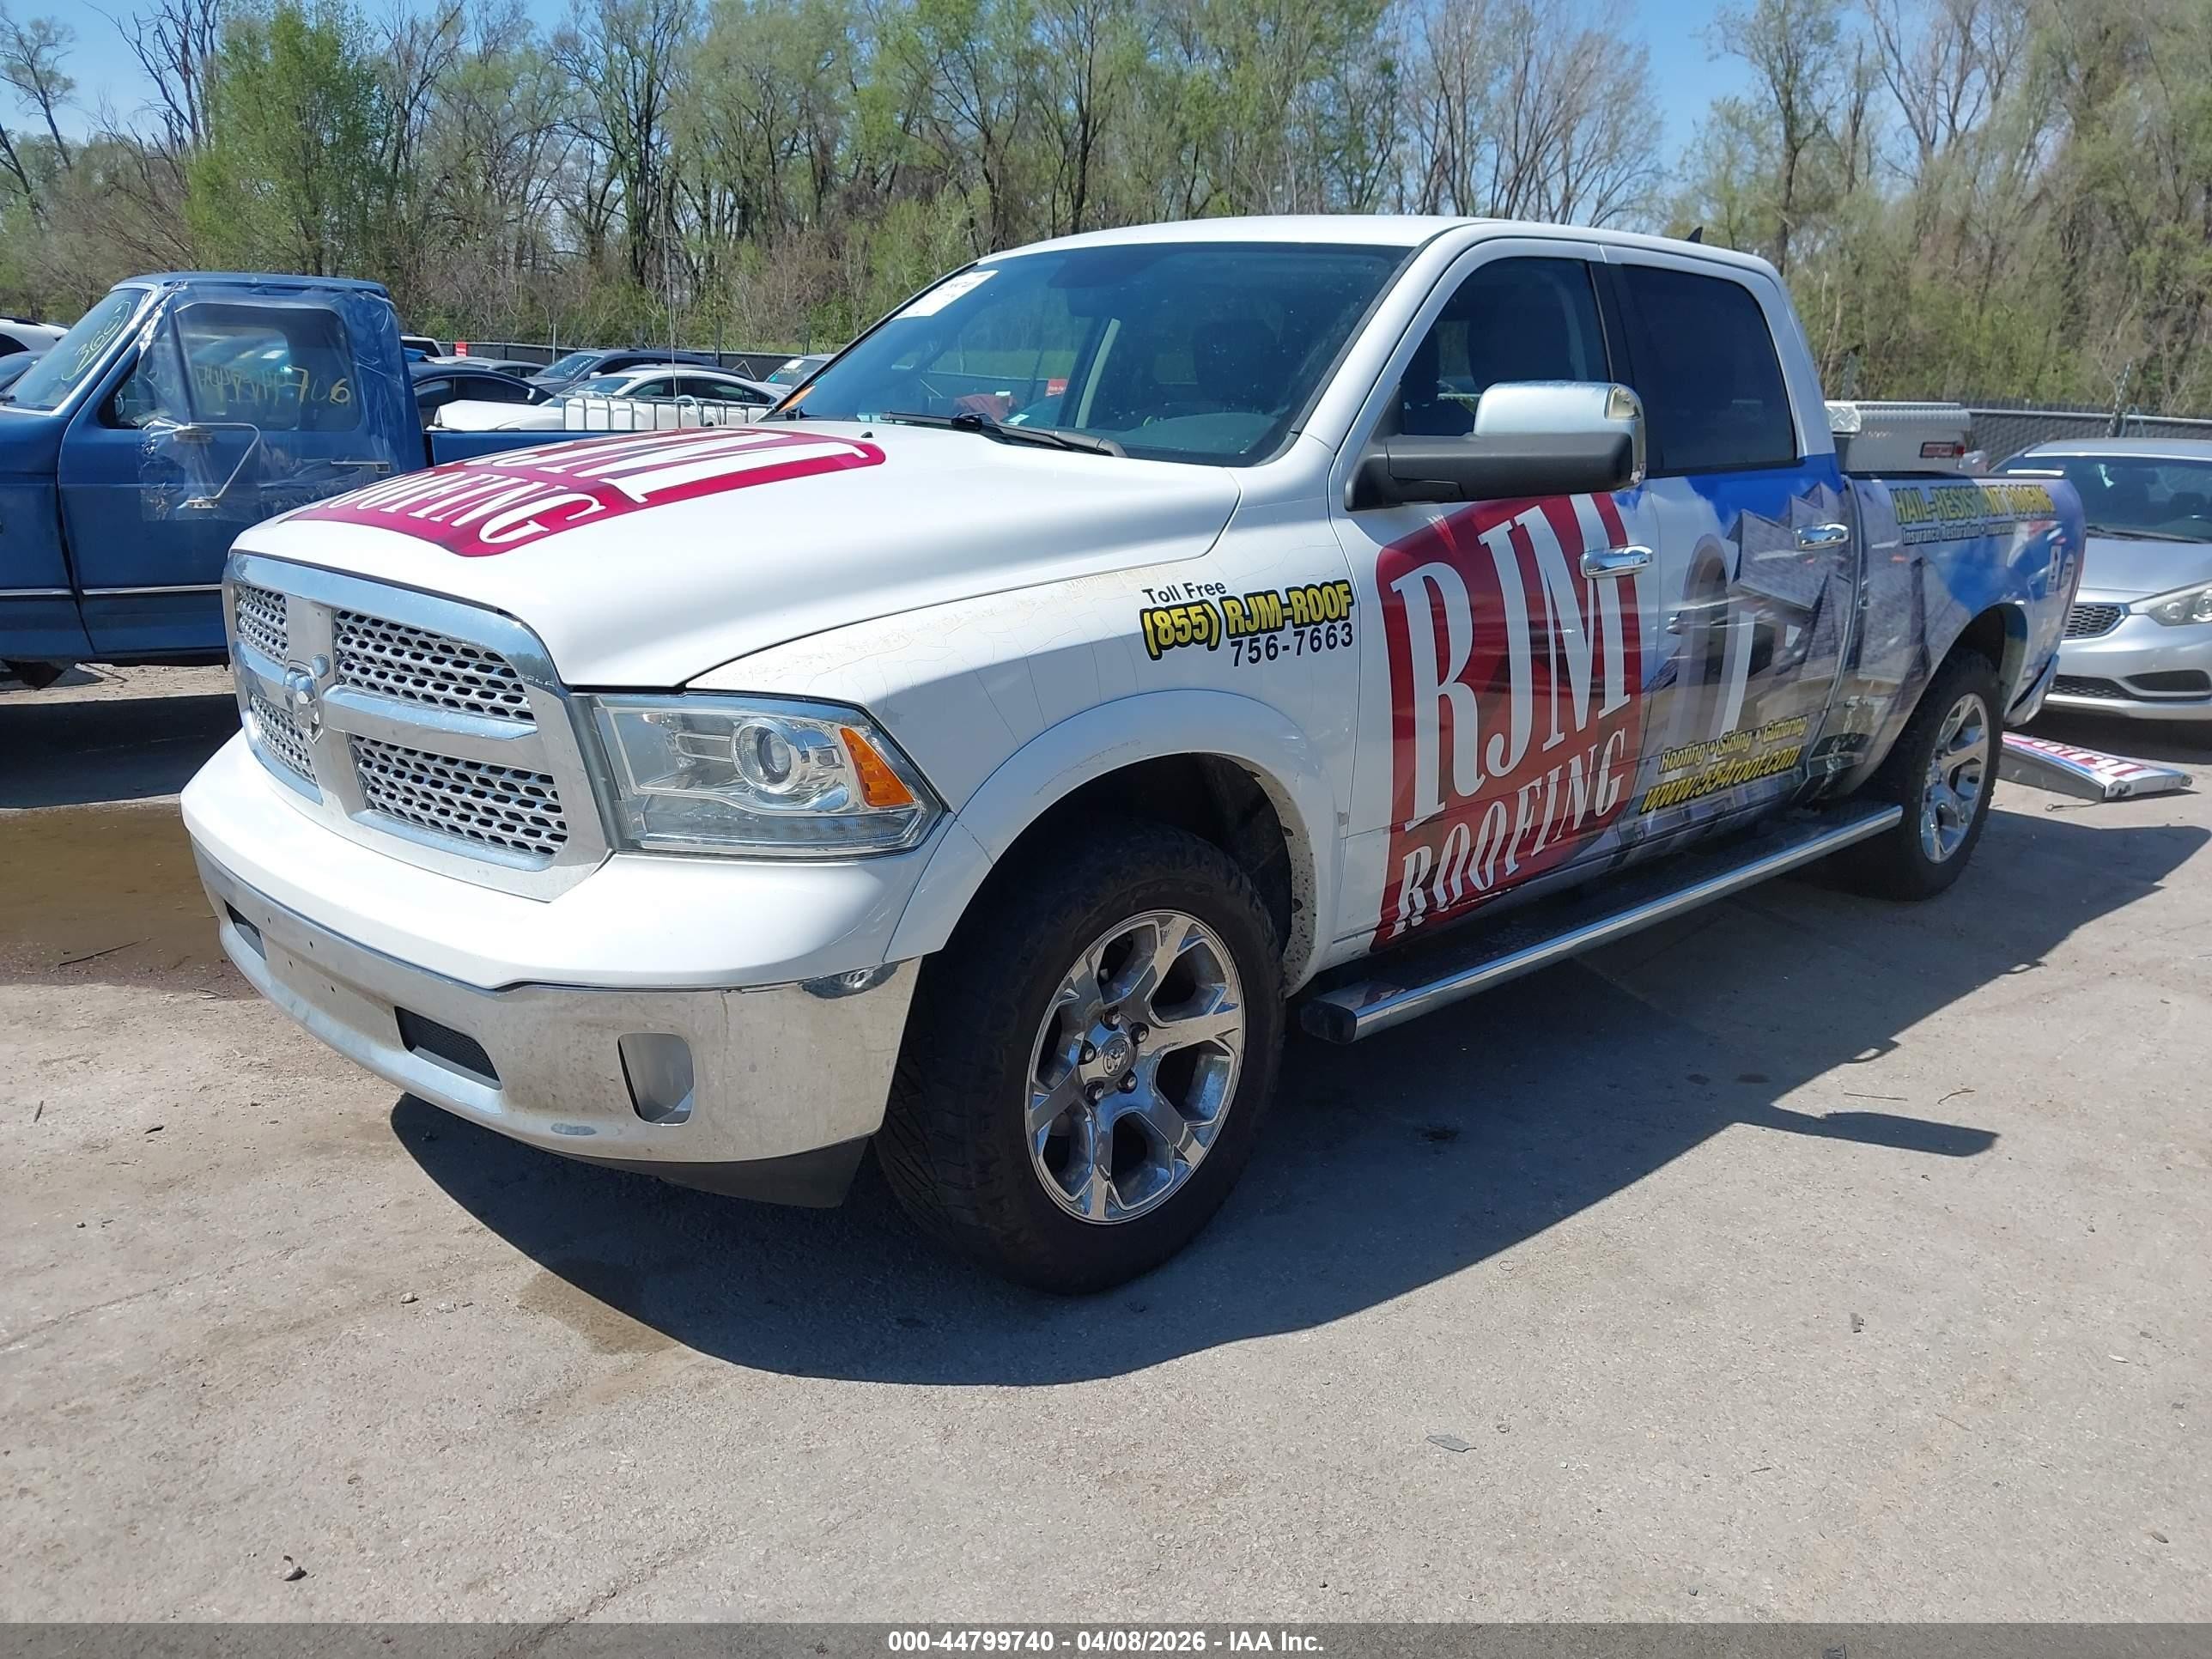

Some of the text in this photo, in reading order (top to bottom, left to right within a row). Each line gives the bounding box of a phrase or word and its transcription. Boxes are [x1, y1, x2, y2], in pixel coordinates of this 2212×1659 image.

[1139, 580, 1354, 660] (855) RJM-ROOF
[1142, 581, 1227, 605] Toll Free
[1230, 622, 1354, 667] 756-7663
[1390, 494, 1631, 830] RJM
[1639, 744, 1802, 815] www.554roof.com
[1659, 742, 1706, 773] Roofing
[1717, 730, 1753, 756] Siding
[1388, 728, 1626, 939] ROOFING
